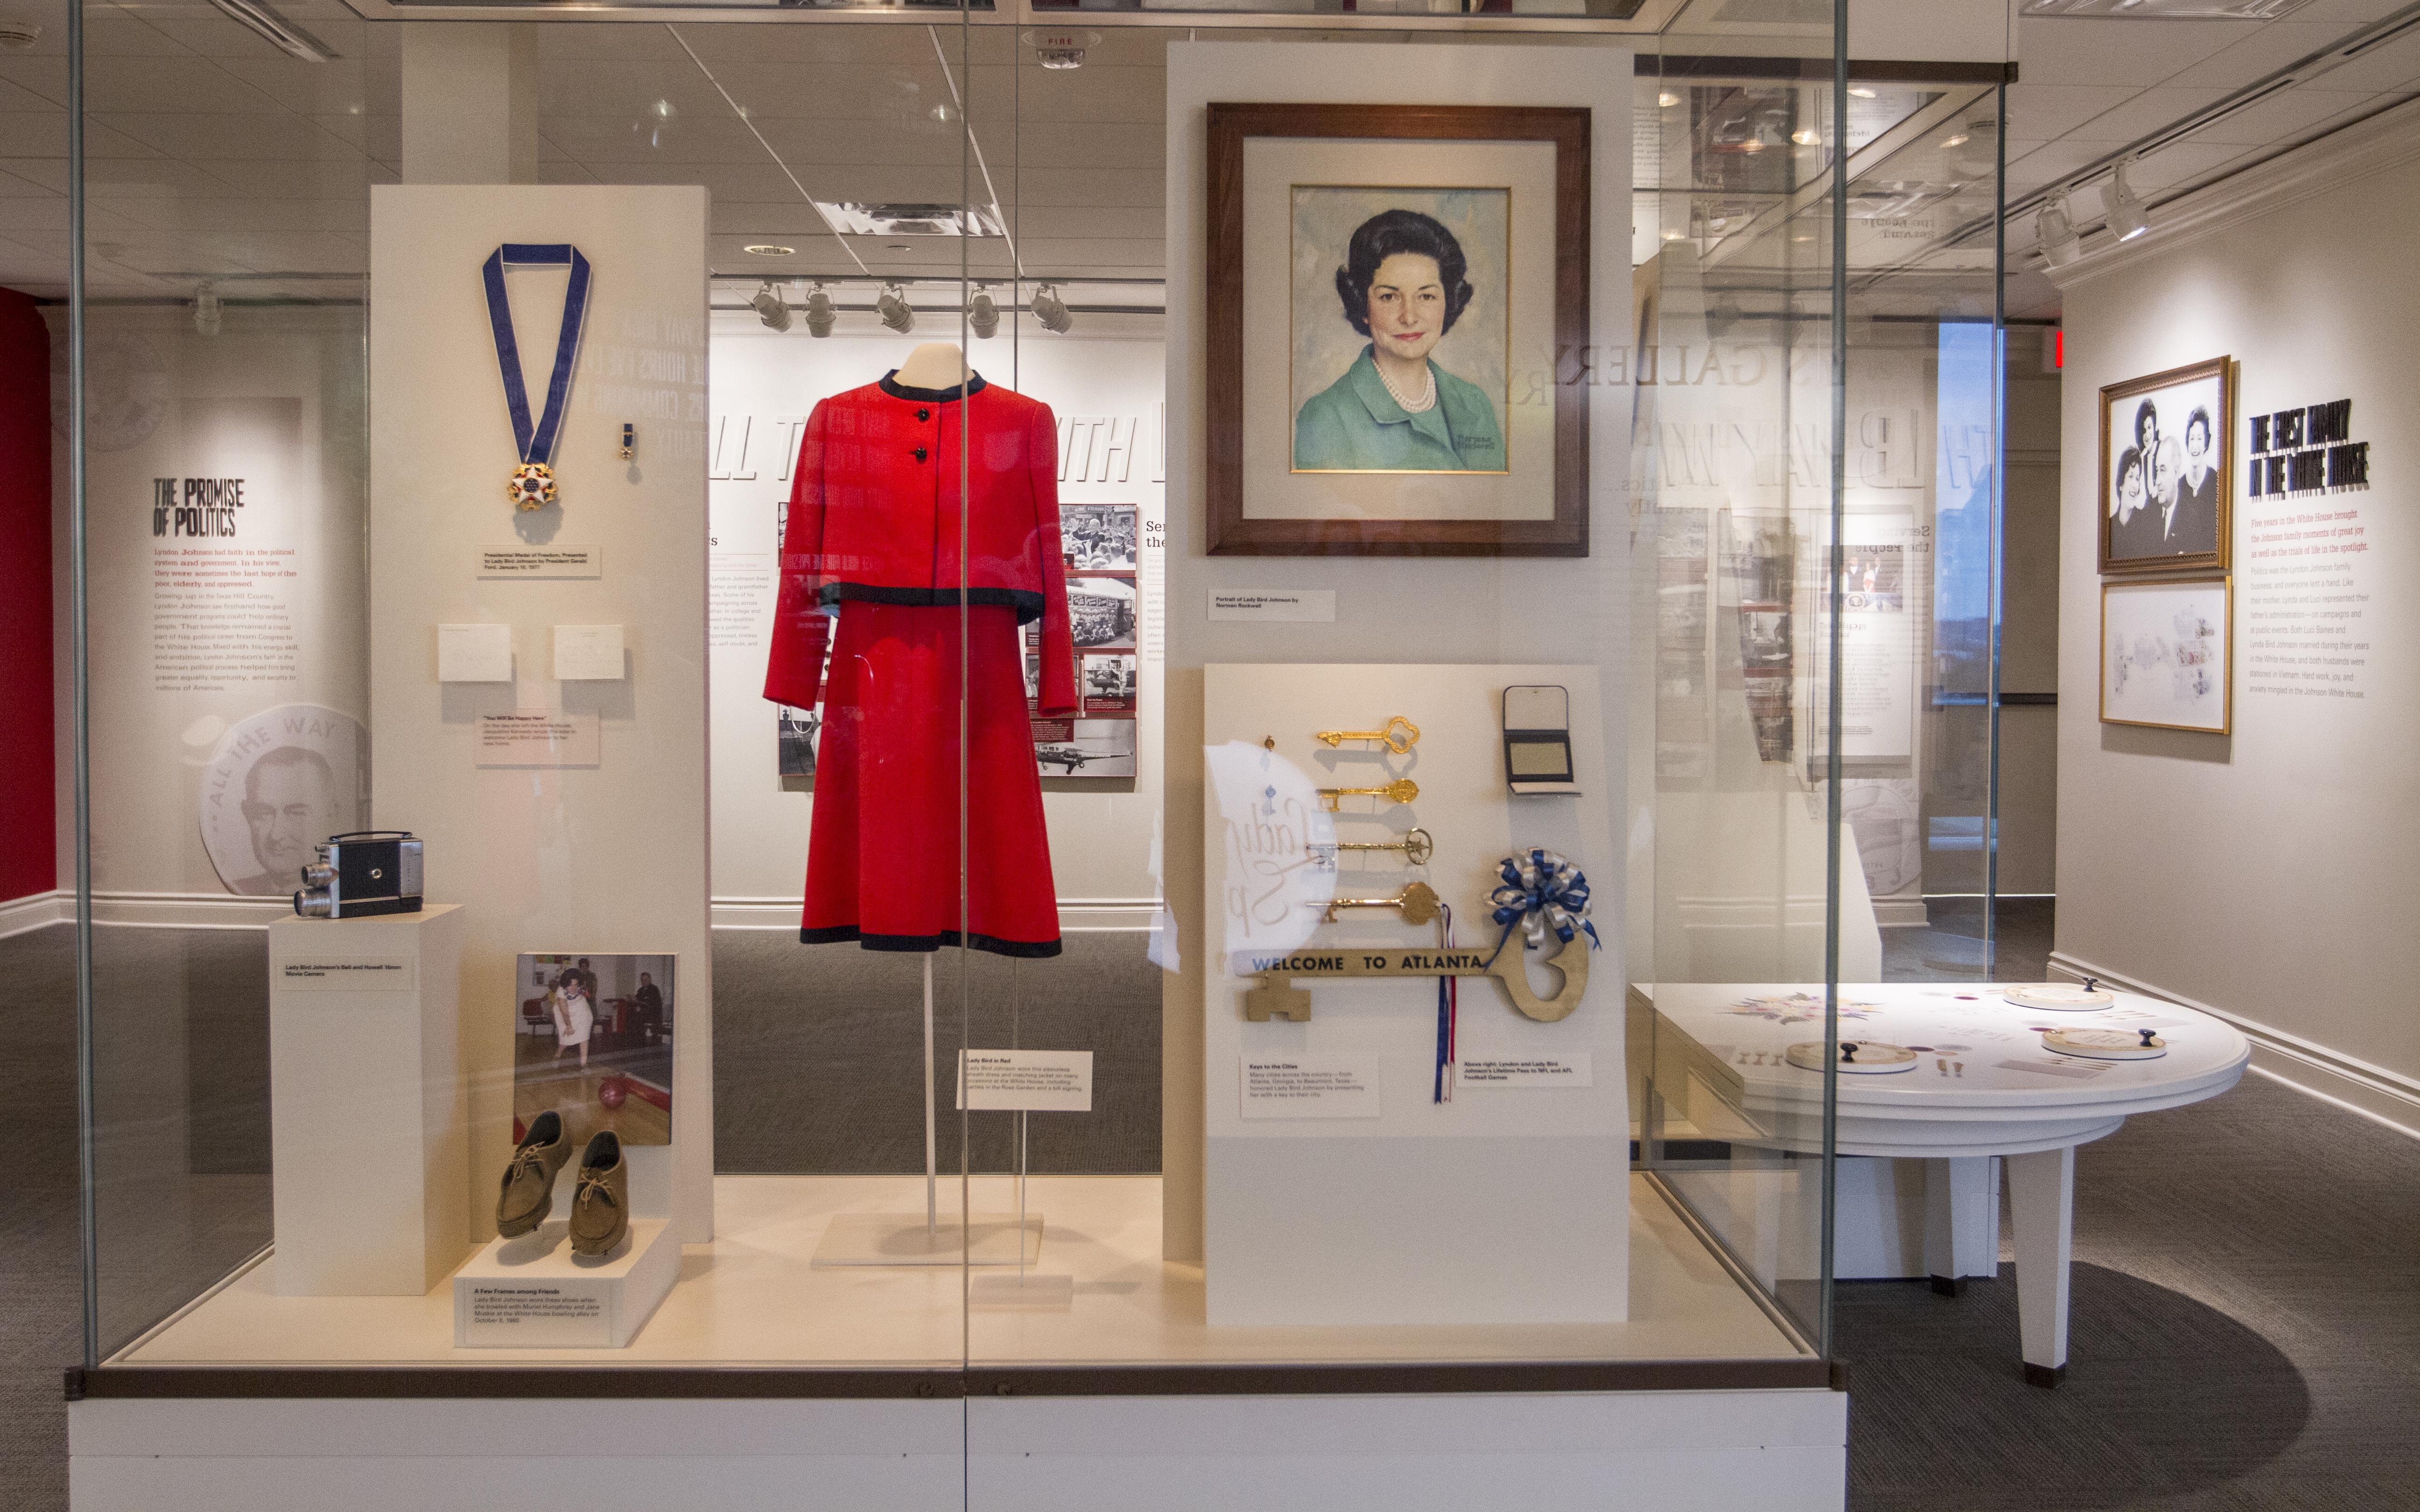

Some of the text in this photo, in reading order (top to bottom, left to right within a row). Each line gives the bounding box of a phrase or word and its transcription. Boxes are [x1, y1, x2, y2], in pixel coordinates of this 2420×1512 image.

[154, 478, 245, 508] THE PROMISE
[153, 507, 236, 537] OF POLITICS
[2251, 519, 2262, 528] Five
[2264, 519, 2278, 529] years
[2286, 516, 2295, 524] the
[2297, 514, 2313, 523] White
[2315, 512, 2333, 521] House
[2334, 510, 2357, 522] brought
[2262, 533, 2282, 542] Johnson
[2284, 531, 2301, 543] family
[2303, 529, 2329, 539] moments
[2338, 528, 2353, 539] great
[2355, 527, 2364, 538] joy
[2258, 549, 2270, 557] well
[2289, 547, 2303, 555] trials
[2312, 545, 2320, 554] life
[2341, 542, 2369, 555] spotlight.
[2250, 641, 2264, 650] Lynda
[2321, 642, 2338, 651] during
[2249, 685, 2266, 695] anxiety
[2268, 686, 2287, 696] mingled
[1252, 955, 1483, 971] WELCOME TO ATLANTA
